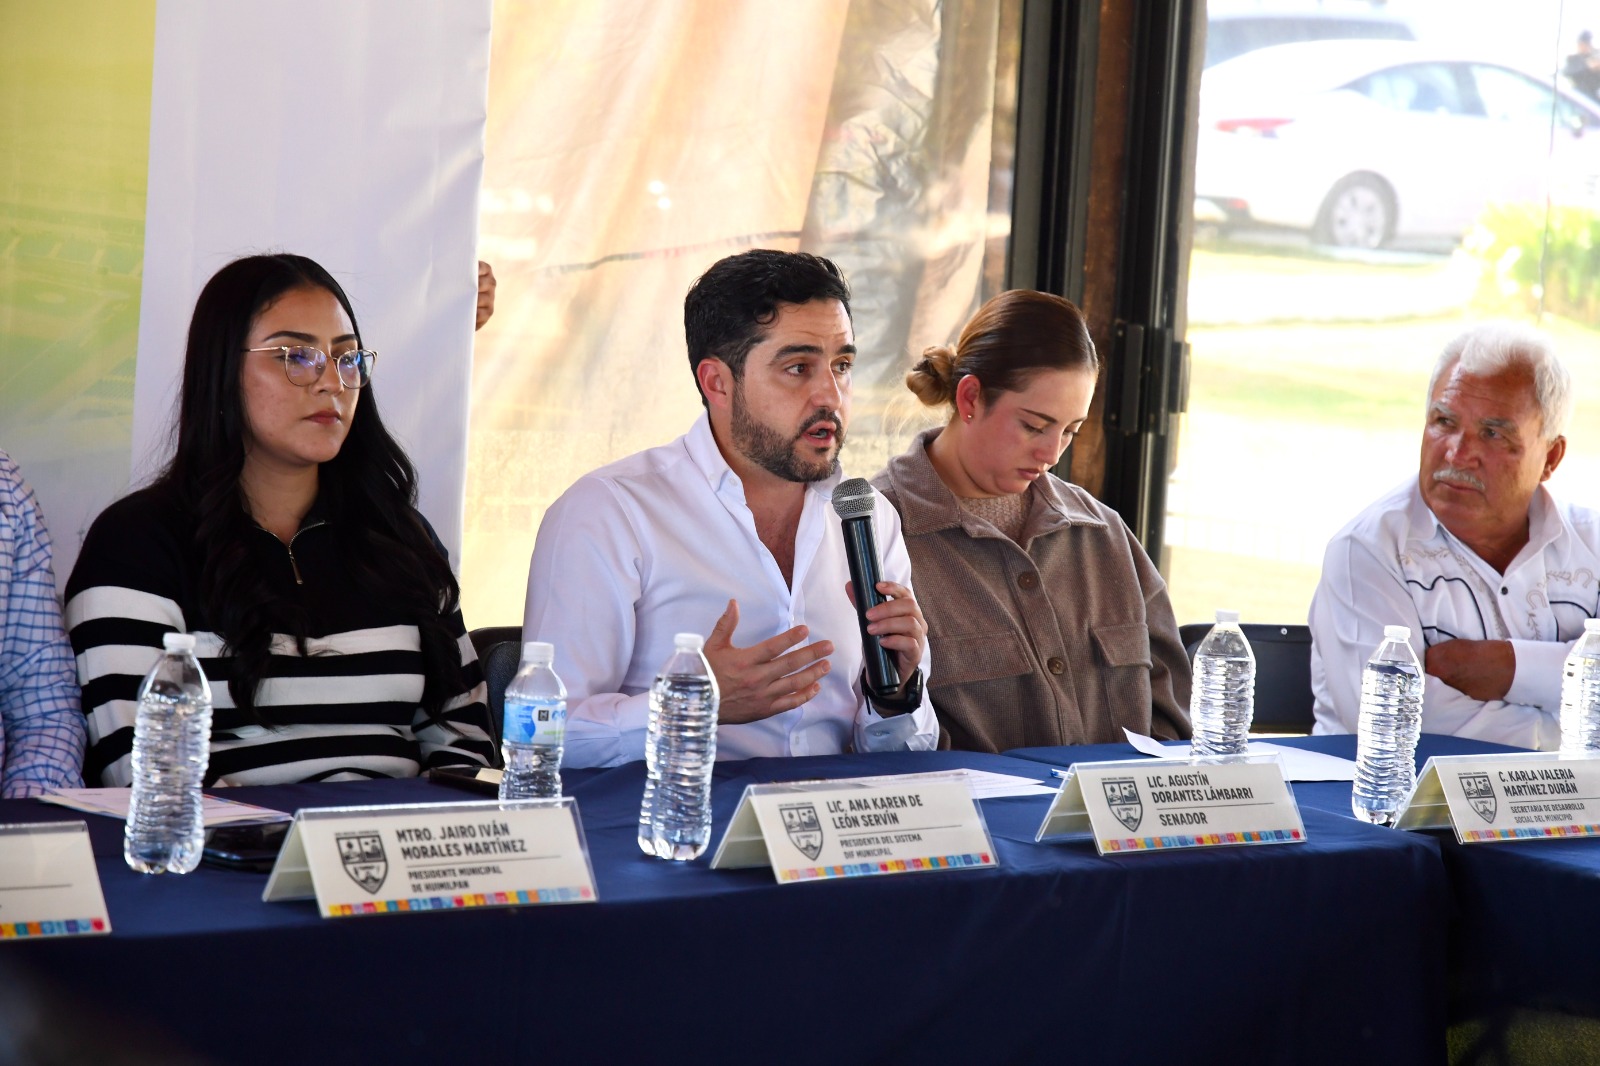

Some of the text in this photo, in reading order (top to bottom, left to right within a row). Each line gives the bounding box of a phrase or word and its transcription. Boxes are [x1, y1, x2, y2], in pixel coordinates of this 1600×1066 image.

[1147, 771, 1210, 788] LIC. AGUSTÍN
[1498, 768, 1576, 783] C. KARLA VALERIA
[1151, 786, 1254, 804] DORANTES LÁMBARRI
[1503, 779, 1578, 797] MARTÍNEZ DURÁN
[826, 794, 923, 813] LIC. ANA KAREN DE
[1510, 802, 1585, 814] SECRETARIA DE DESARROLLO
[832, 810, 900, 829] LEÓN SERVÍN
[1159, 812, 1209, 827] SENADOR
[1514, 813, 1573, 824] SOCIAL DEL MUNICIPIO
[396, 827, 435, 843] MTRO.
[439, 824, 478, 840] JAIRO
[479, 820, 510, 838] IVÁN
[840, 833, 923, 848] PRESIDENTA DEL SISTEMA
[401, 838, 527, 860] MORALES MARTÍNEZ
[844, 848, 893, 859] DIF MUNICIPAL
[408, 865, 503, 880] PRESIDENTE MUNICIPAL
[411, 880, 470, 893] DE HUIMILPAN
